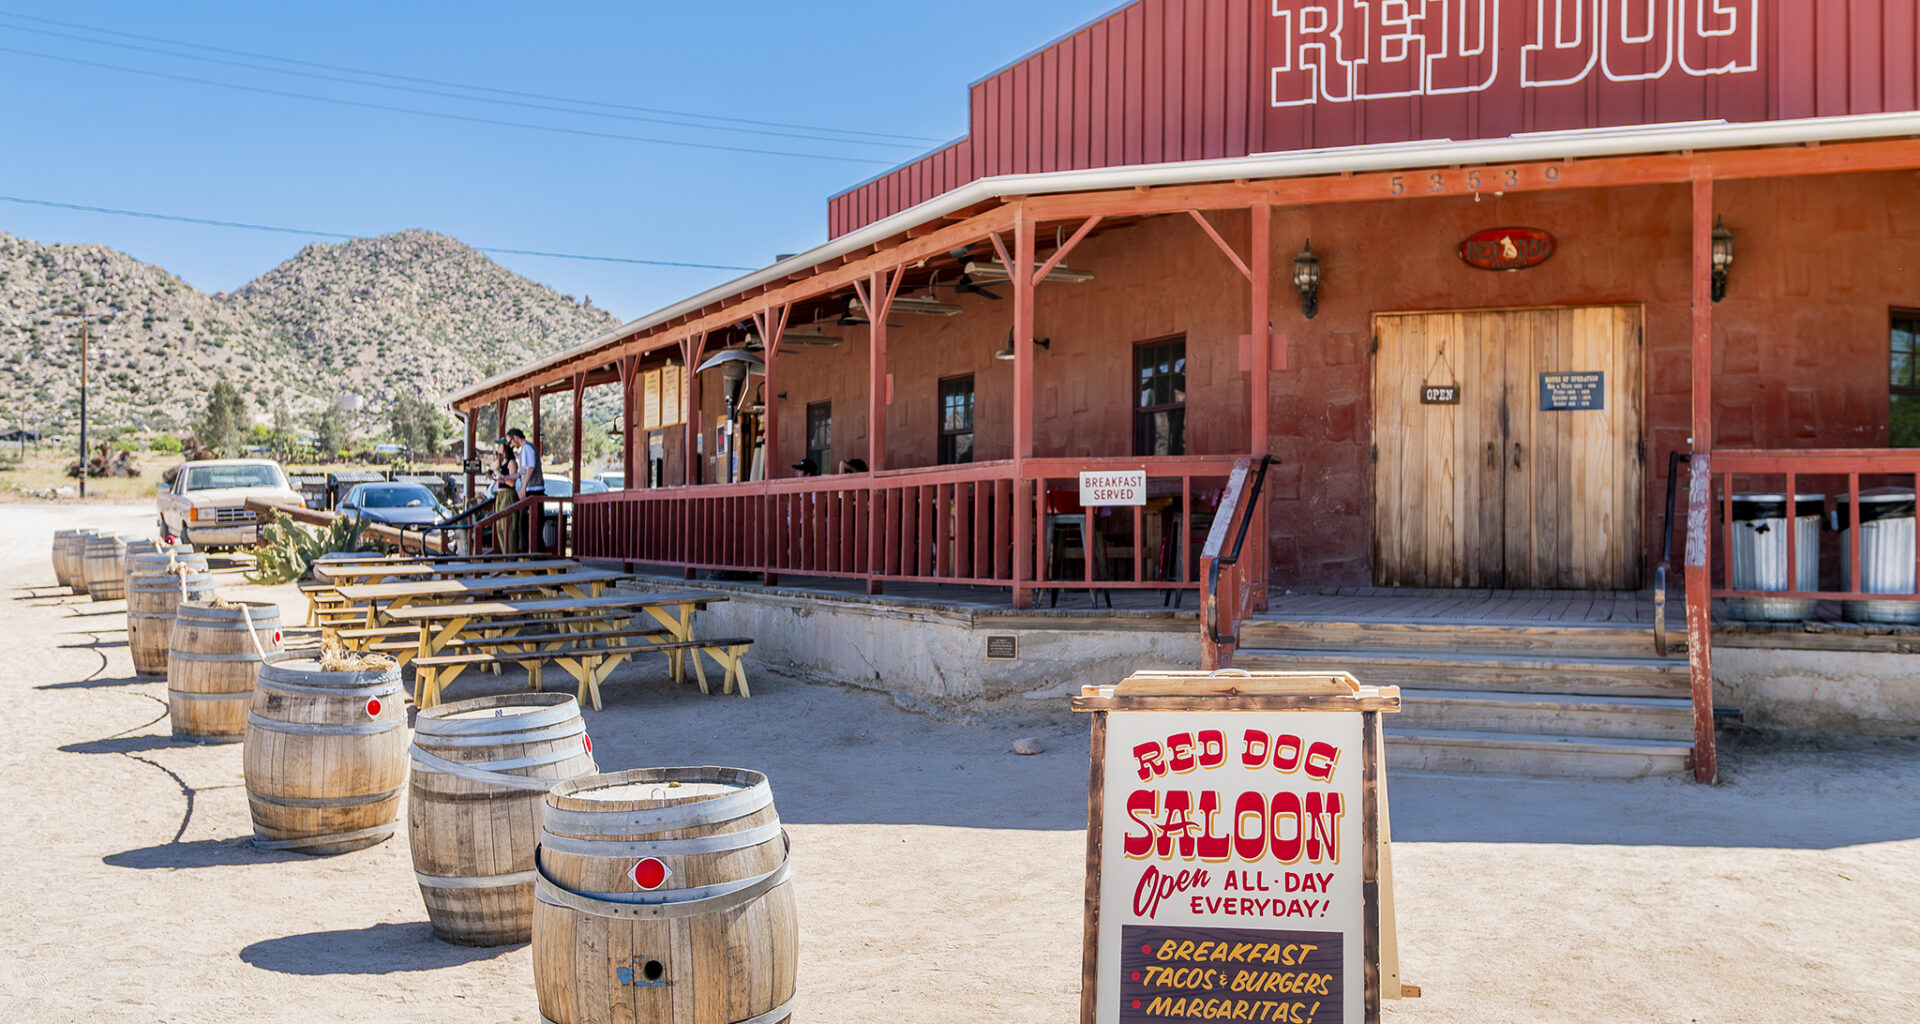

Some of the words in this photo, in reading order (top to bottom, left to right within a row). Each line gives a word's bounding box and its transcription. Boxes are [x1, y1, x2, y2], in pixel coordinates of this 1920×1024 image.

[1271, 0, 1500, 107] RED
[1467, 240, 1500, 261] RED
[1518, 238, 1551, 258] DOG
[1426, 388, 1454, 401] OPEN
[1085, 476, 1142, 488] BREAKFAST
[1094, 489, 1134, 500] SERVED
[1132, 729, 1228, 782] RED
[1241, 728, 1342, 784] DOG
[1123, 789, 1345, 866] SALOON
[1133, 864, 1211, 919] Open
[1190, 896, 1330, 918] EVERYDAY!
[1156, 939, 1318, 966] BREAKFAST
[1143, 966, 1217, 990] TACOS
[1230, 970, 1333, 995] BURGERS
[1146, 996, 1320, 1024] MARGARITAS!
